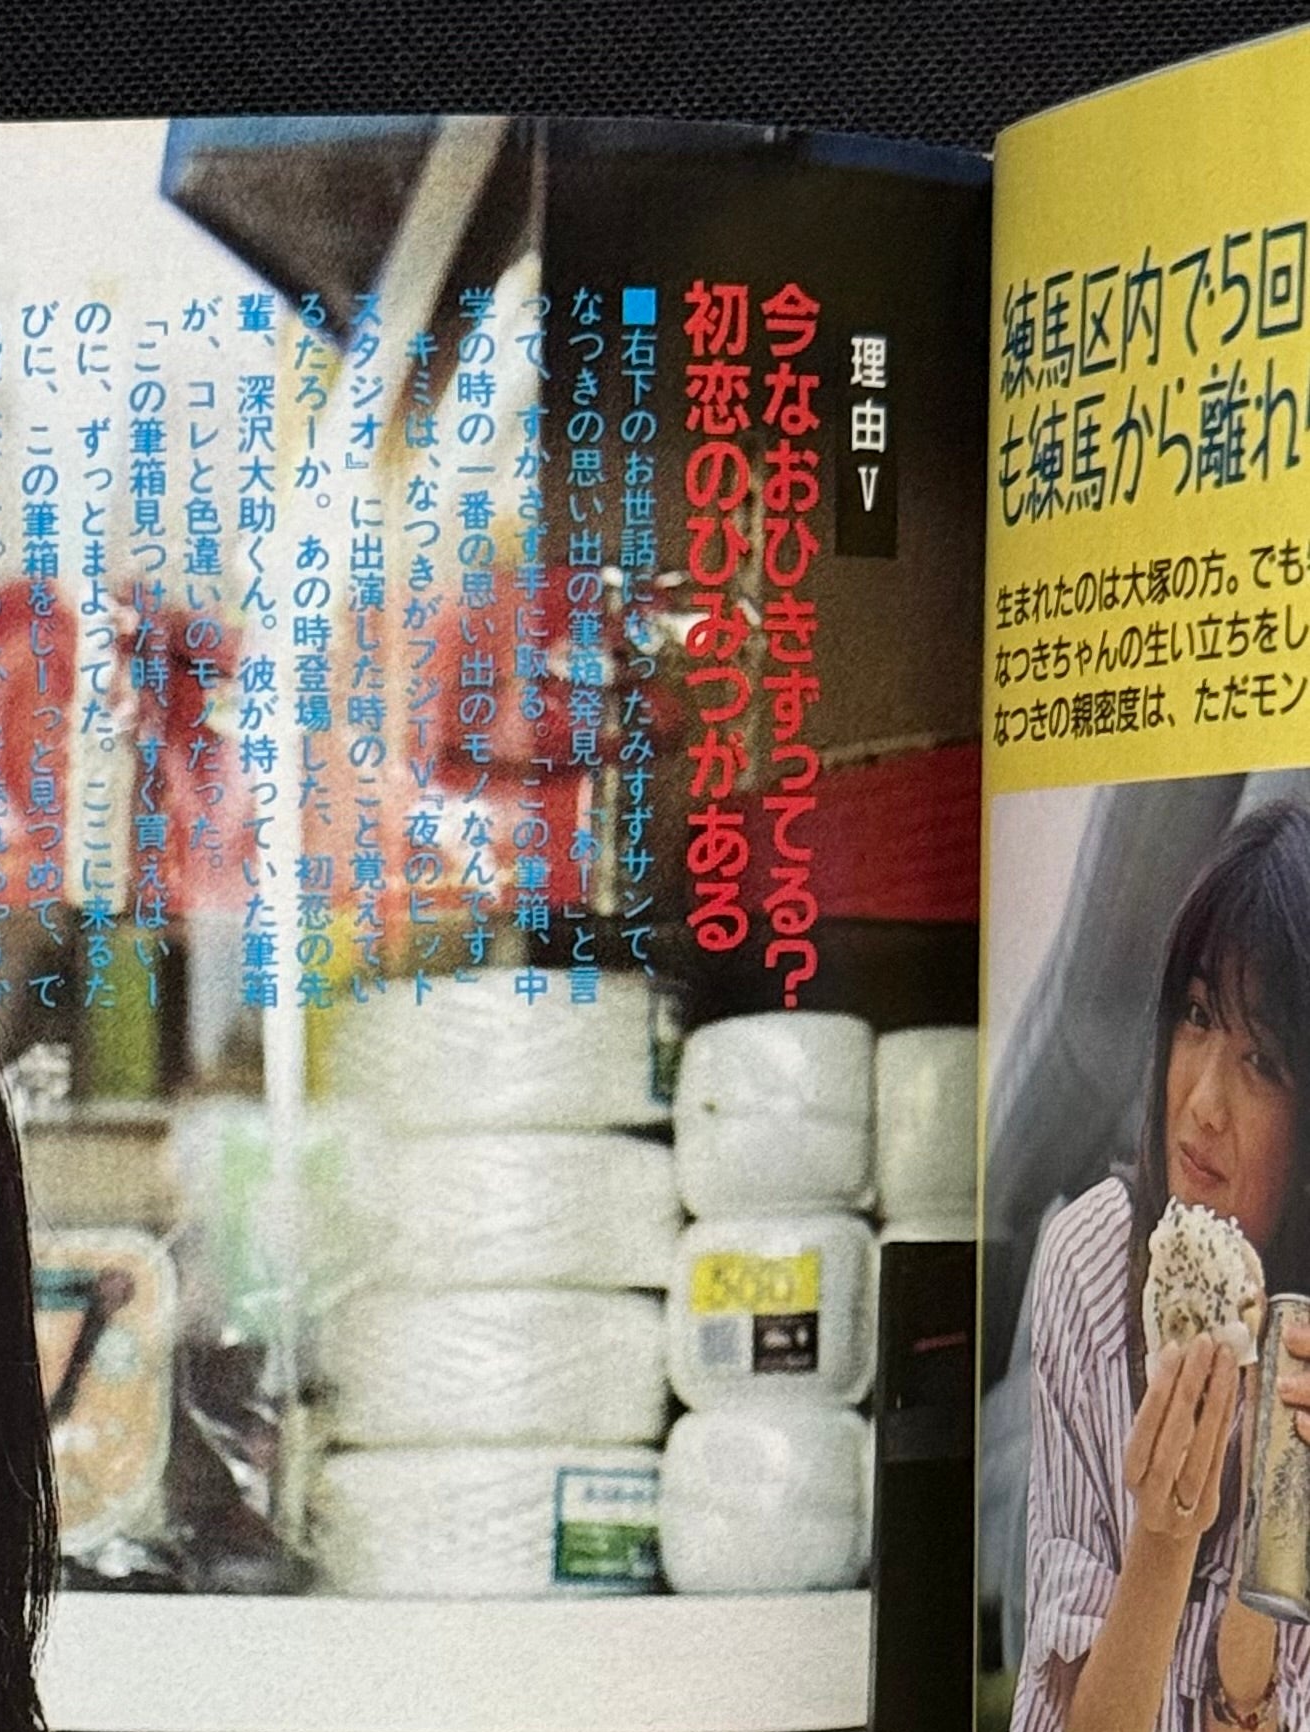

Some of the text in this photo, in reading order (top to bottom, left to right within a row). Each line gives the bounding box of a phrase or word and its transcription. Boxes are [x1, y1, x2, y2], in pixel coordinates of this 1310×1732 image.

[1000, 220, 1309, 402] 練馬区内で5回
[998, 356, 1310, 528] も練馬から離れ
[684, 280, 752, 952] 初恋のひみつがある
[760, 282, 821, 1009] 今なおひきずってる?
[996, 539, 1310, 630] 生まれたのは大塚の方。でも
